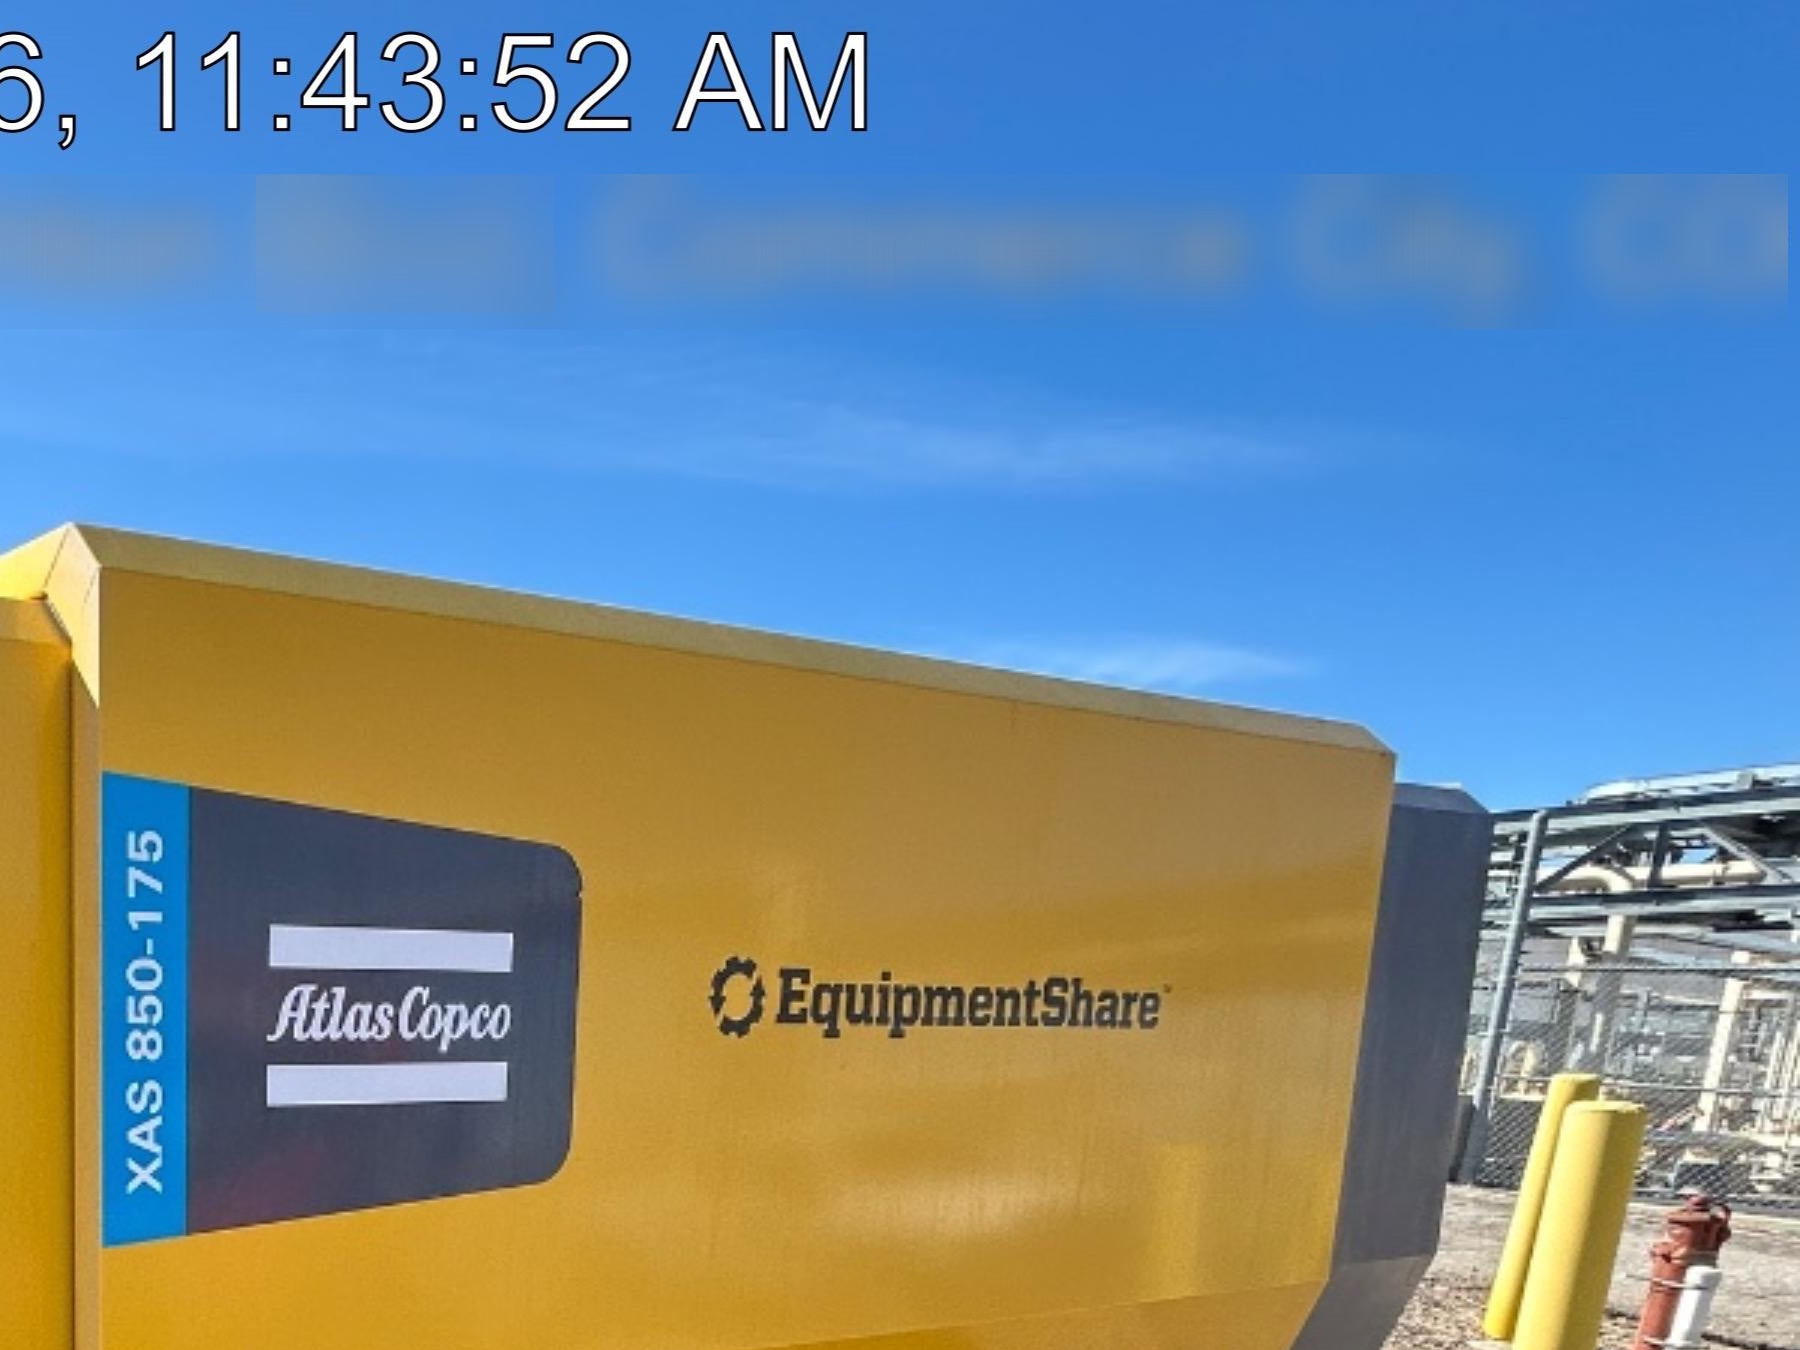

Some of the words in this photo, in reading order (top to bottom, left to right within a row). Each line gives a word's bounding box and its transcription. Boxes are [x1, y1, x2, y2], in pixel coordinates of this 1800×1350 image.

[125, 829, 163, 1062] 850-175
[776, 967, 1162, 1039] EquipmentShare
[125, 1081, 163, 1194] XAS
